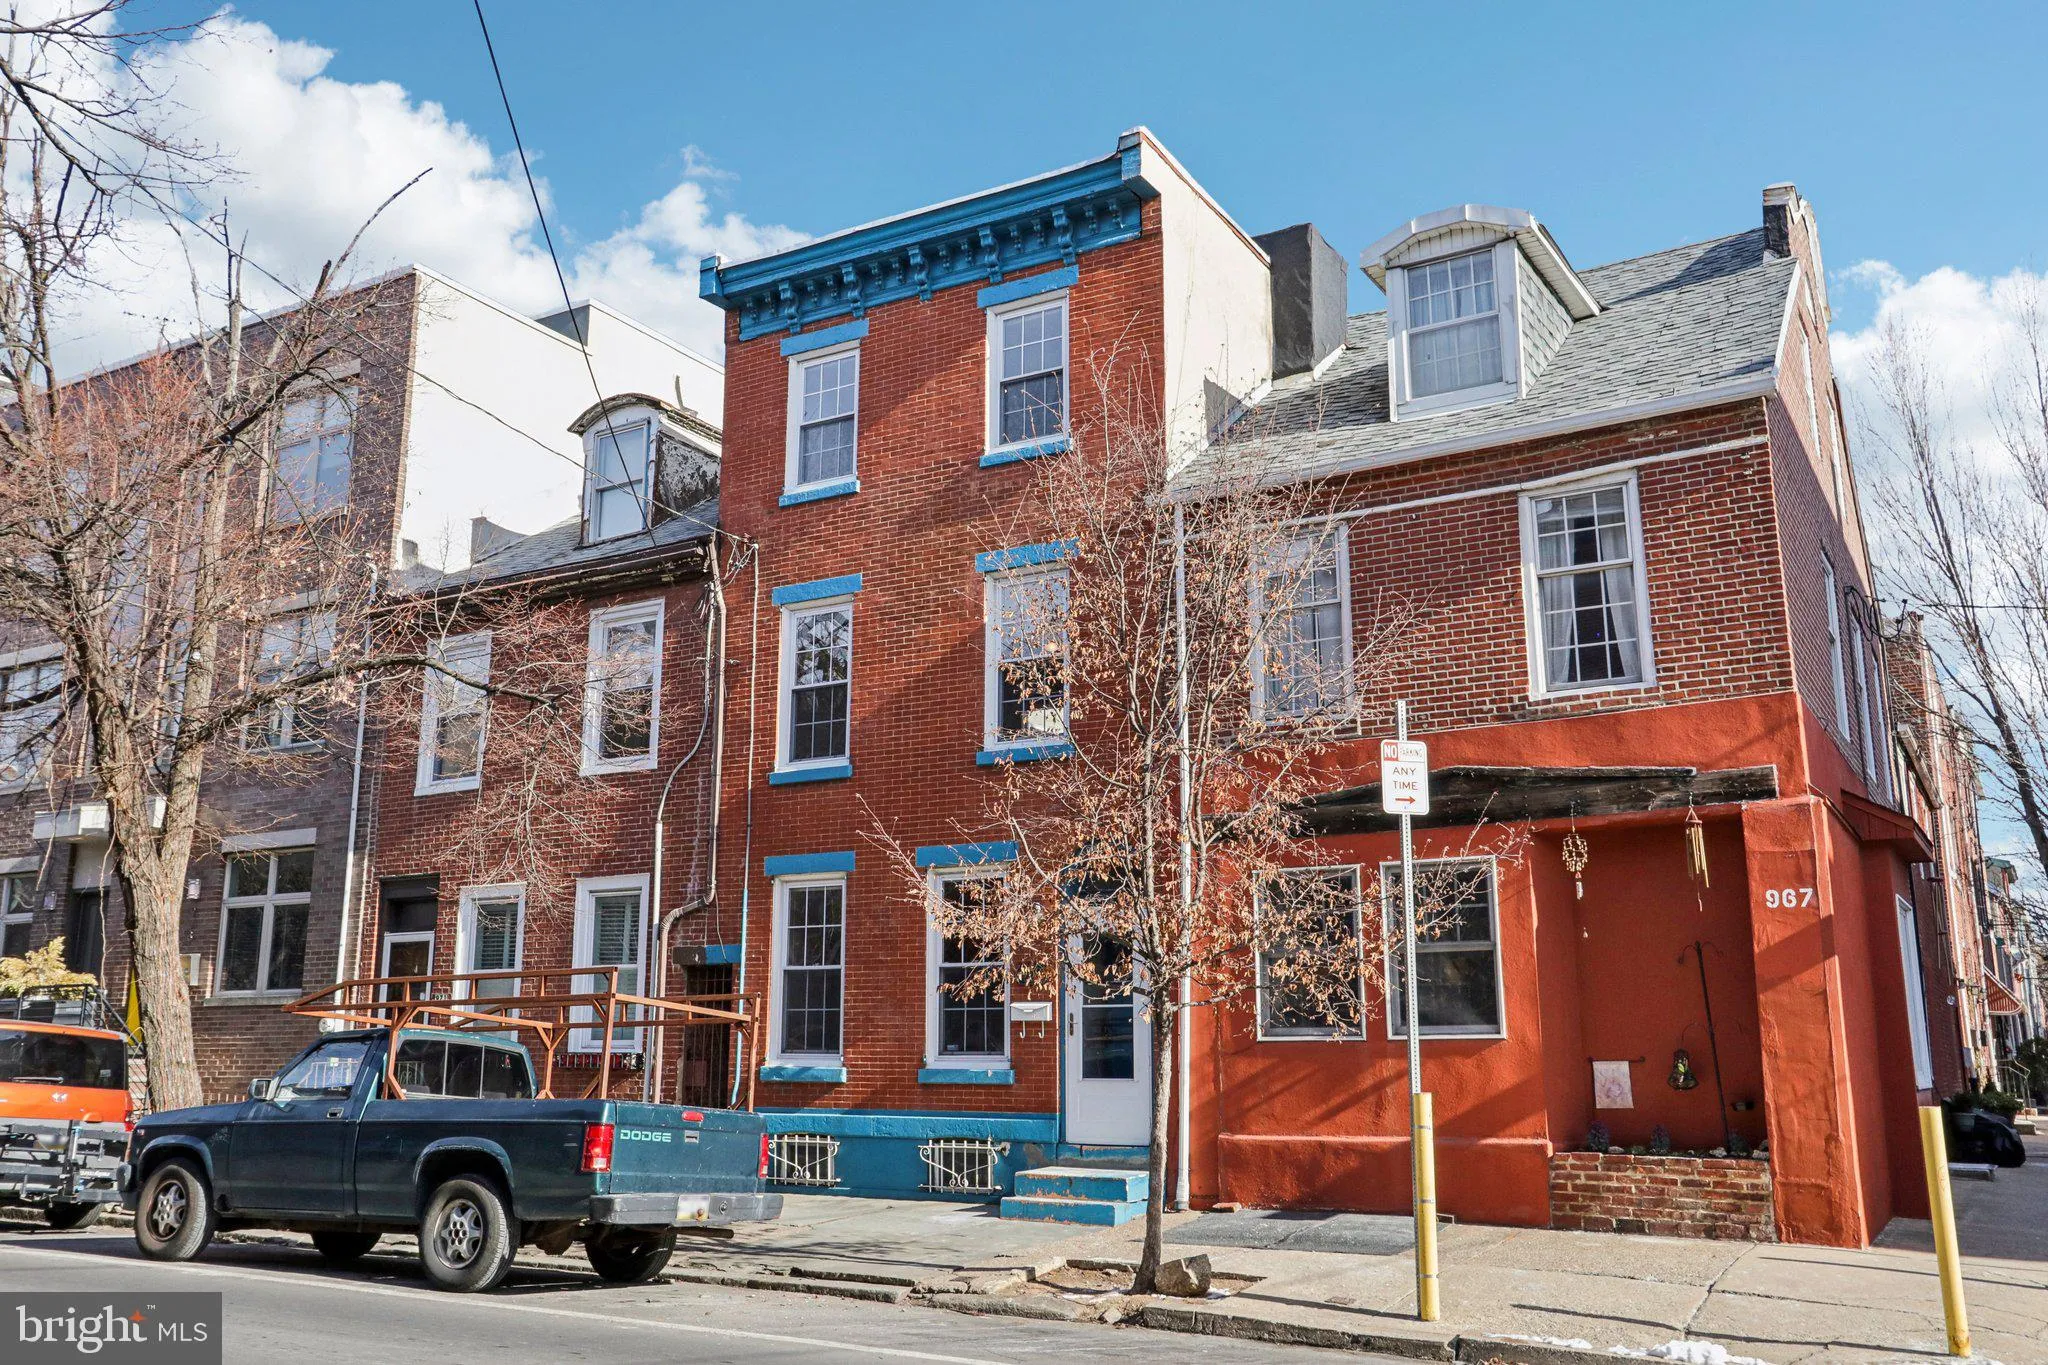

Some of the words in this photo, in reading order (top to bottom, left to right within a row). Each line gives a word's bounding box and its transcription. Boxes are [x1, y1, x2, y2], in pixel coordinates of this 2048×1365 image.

[1384, 745, 1397, 758] NO
[1393, 767, 1416, 775] ANY
[1393, 780, 1418, 790] TIME
[1765, 888, 1813, 909] 967
[620, 1129, 672, 1143] DODGE
